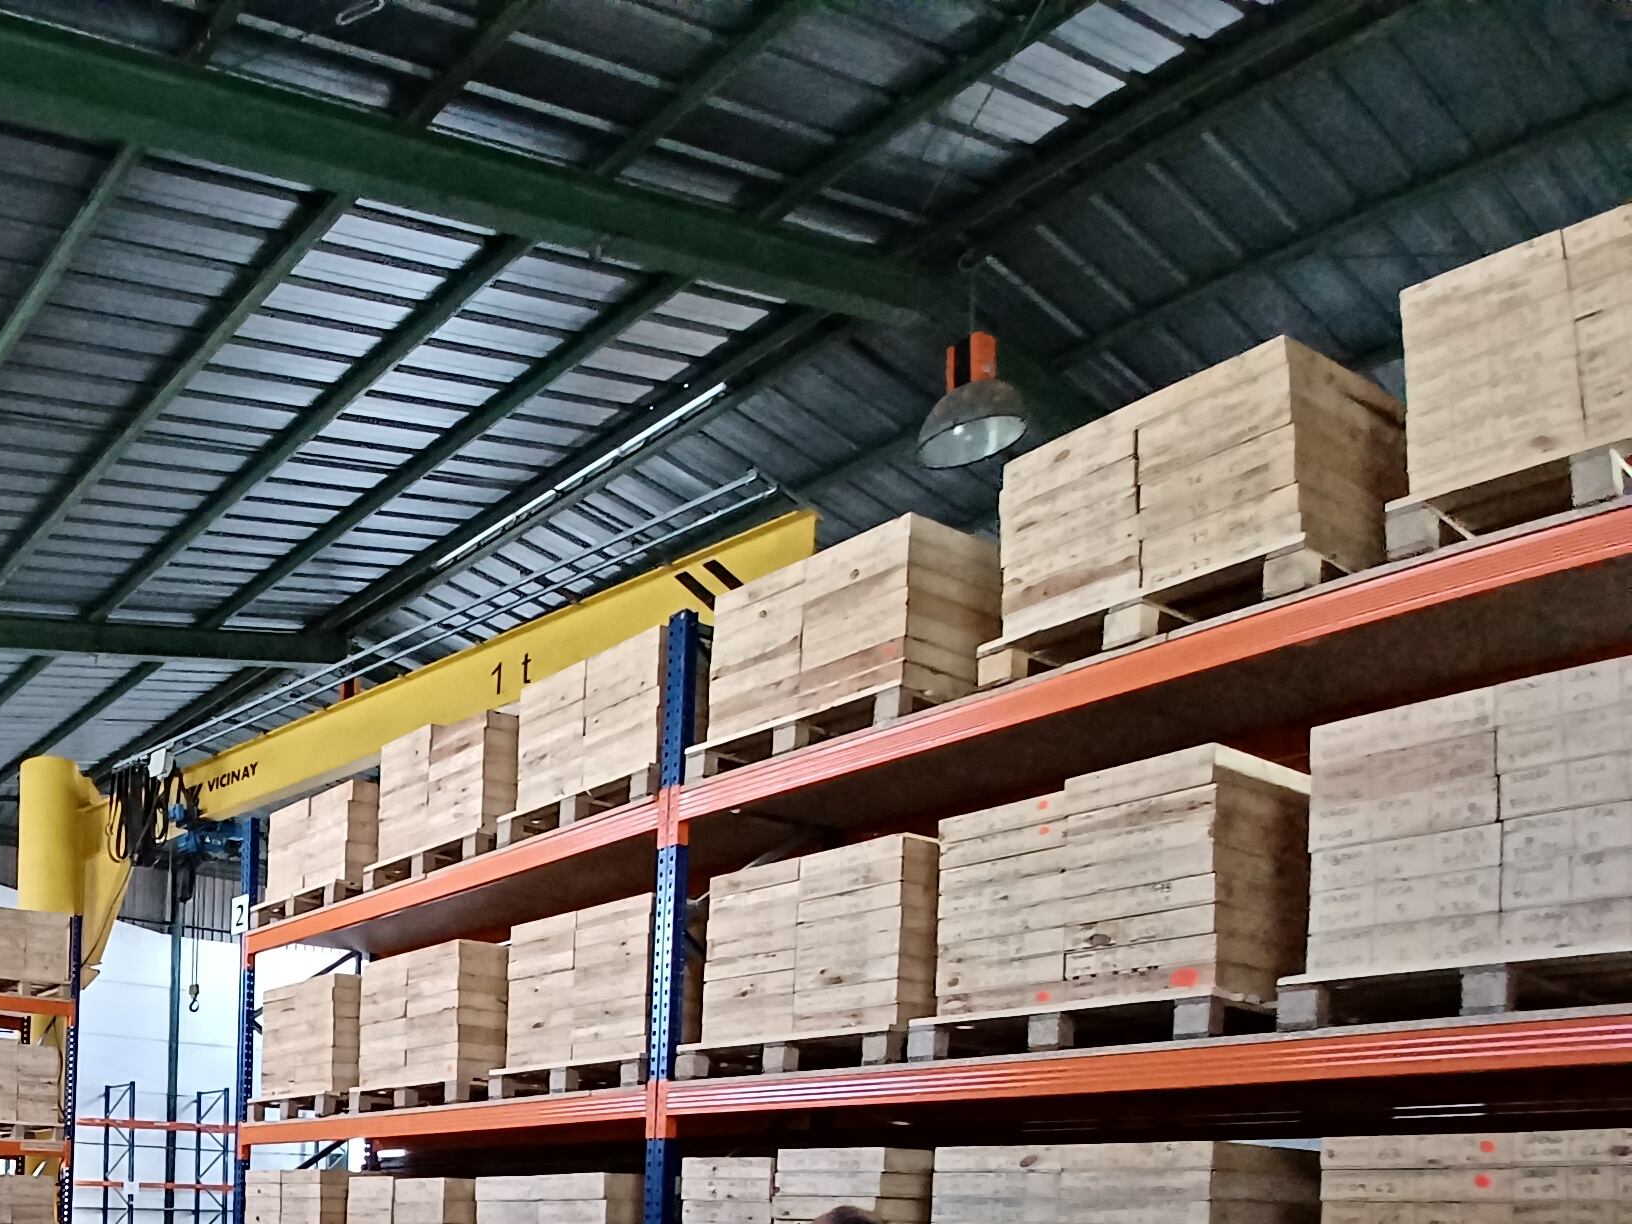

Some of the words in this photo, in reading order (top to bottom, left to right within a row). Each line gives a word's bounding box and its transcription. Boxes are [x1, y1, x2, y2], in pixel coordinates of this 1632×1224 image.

[490, 661, 503, 695] 1
[521, 652, 532, 684] t
[207, 761, 259, 792] VICINAY
[235, 904, 244, 927] 2
